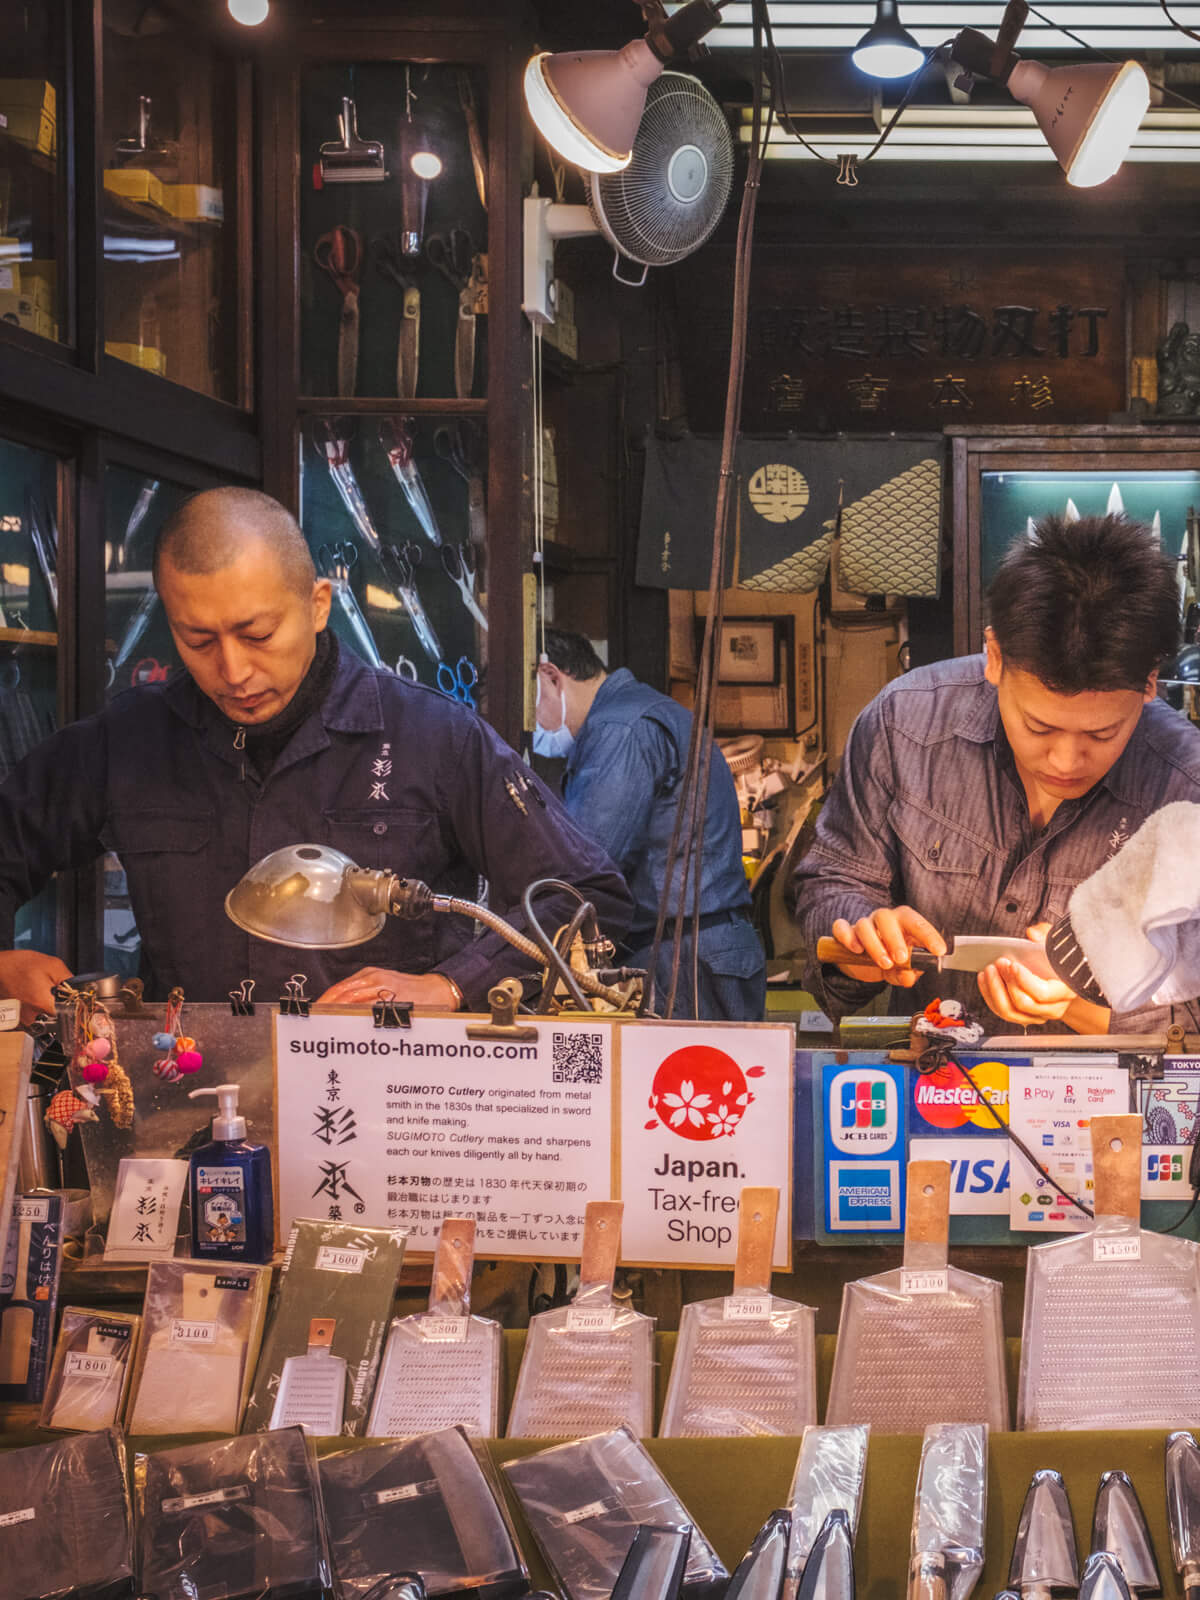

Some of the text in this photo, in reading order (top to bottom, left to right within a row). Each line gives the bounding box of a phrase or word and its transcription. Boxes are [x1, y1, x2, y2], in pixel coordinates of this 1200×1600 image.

[290, 1037, 538, 1061] sugimoto-hamono.com
[1171, 1061, 1200, 1069] TOKYO
[326, 1069, 341, 1102] 東京
[386, 1084, 592, 1101] SUGIMOTO Cutlery originated from metal
[1087, 1087, 1115, 1096] Rakuten
[917, 1085, 1010, 1106] MasterCar
[1034, 1087, 1055, 1100] Pay
[386, 1100, 592, 1116] smith in the 1830s that specialized in sword
[841, 1099, 886, 1110] JCB
[386, 1115, 469, 1129] and knife making.
[1053, 1120, 1071, 1128] VISA
[386, 1131, 592, 1149] SUGIMOTO Cutlery makes and sharpens
[840, 1132, 888, 1141] JCB CARDS
[386, 1147, 562, 1162] each our knives diligently all by hand.
[654, 1153, 746, 1182] Japan.
[387, 1175, 588, 1192] 杉本刃物の歴史は 1830 年代天保初期の
[839, 1187, 888, 1196] AMERICAN
[648, 1188, 740, 1213] Tax-fre
[850, 1198, 892, 1206] EXPRESS
[667, 1218, 732, 1249] Shop
[283, 1228, 300, 1272] SUGIMOTO
[332, 1254, 359, 1266] 1600
[217, 1279, 248, 1287] SAMPLE
[177, 1328, 209, 1339] 3100
[77, 1359, 107, 1372] 1800
[352, 1359, 369, 1408] SUGIMOTO
